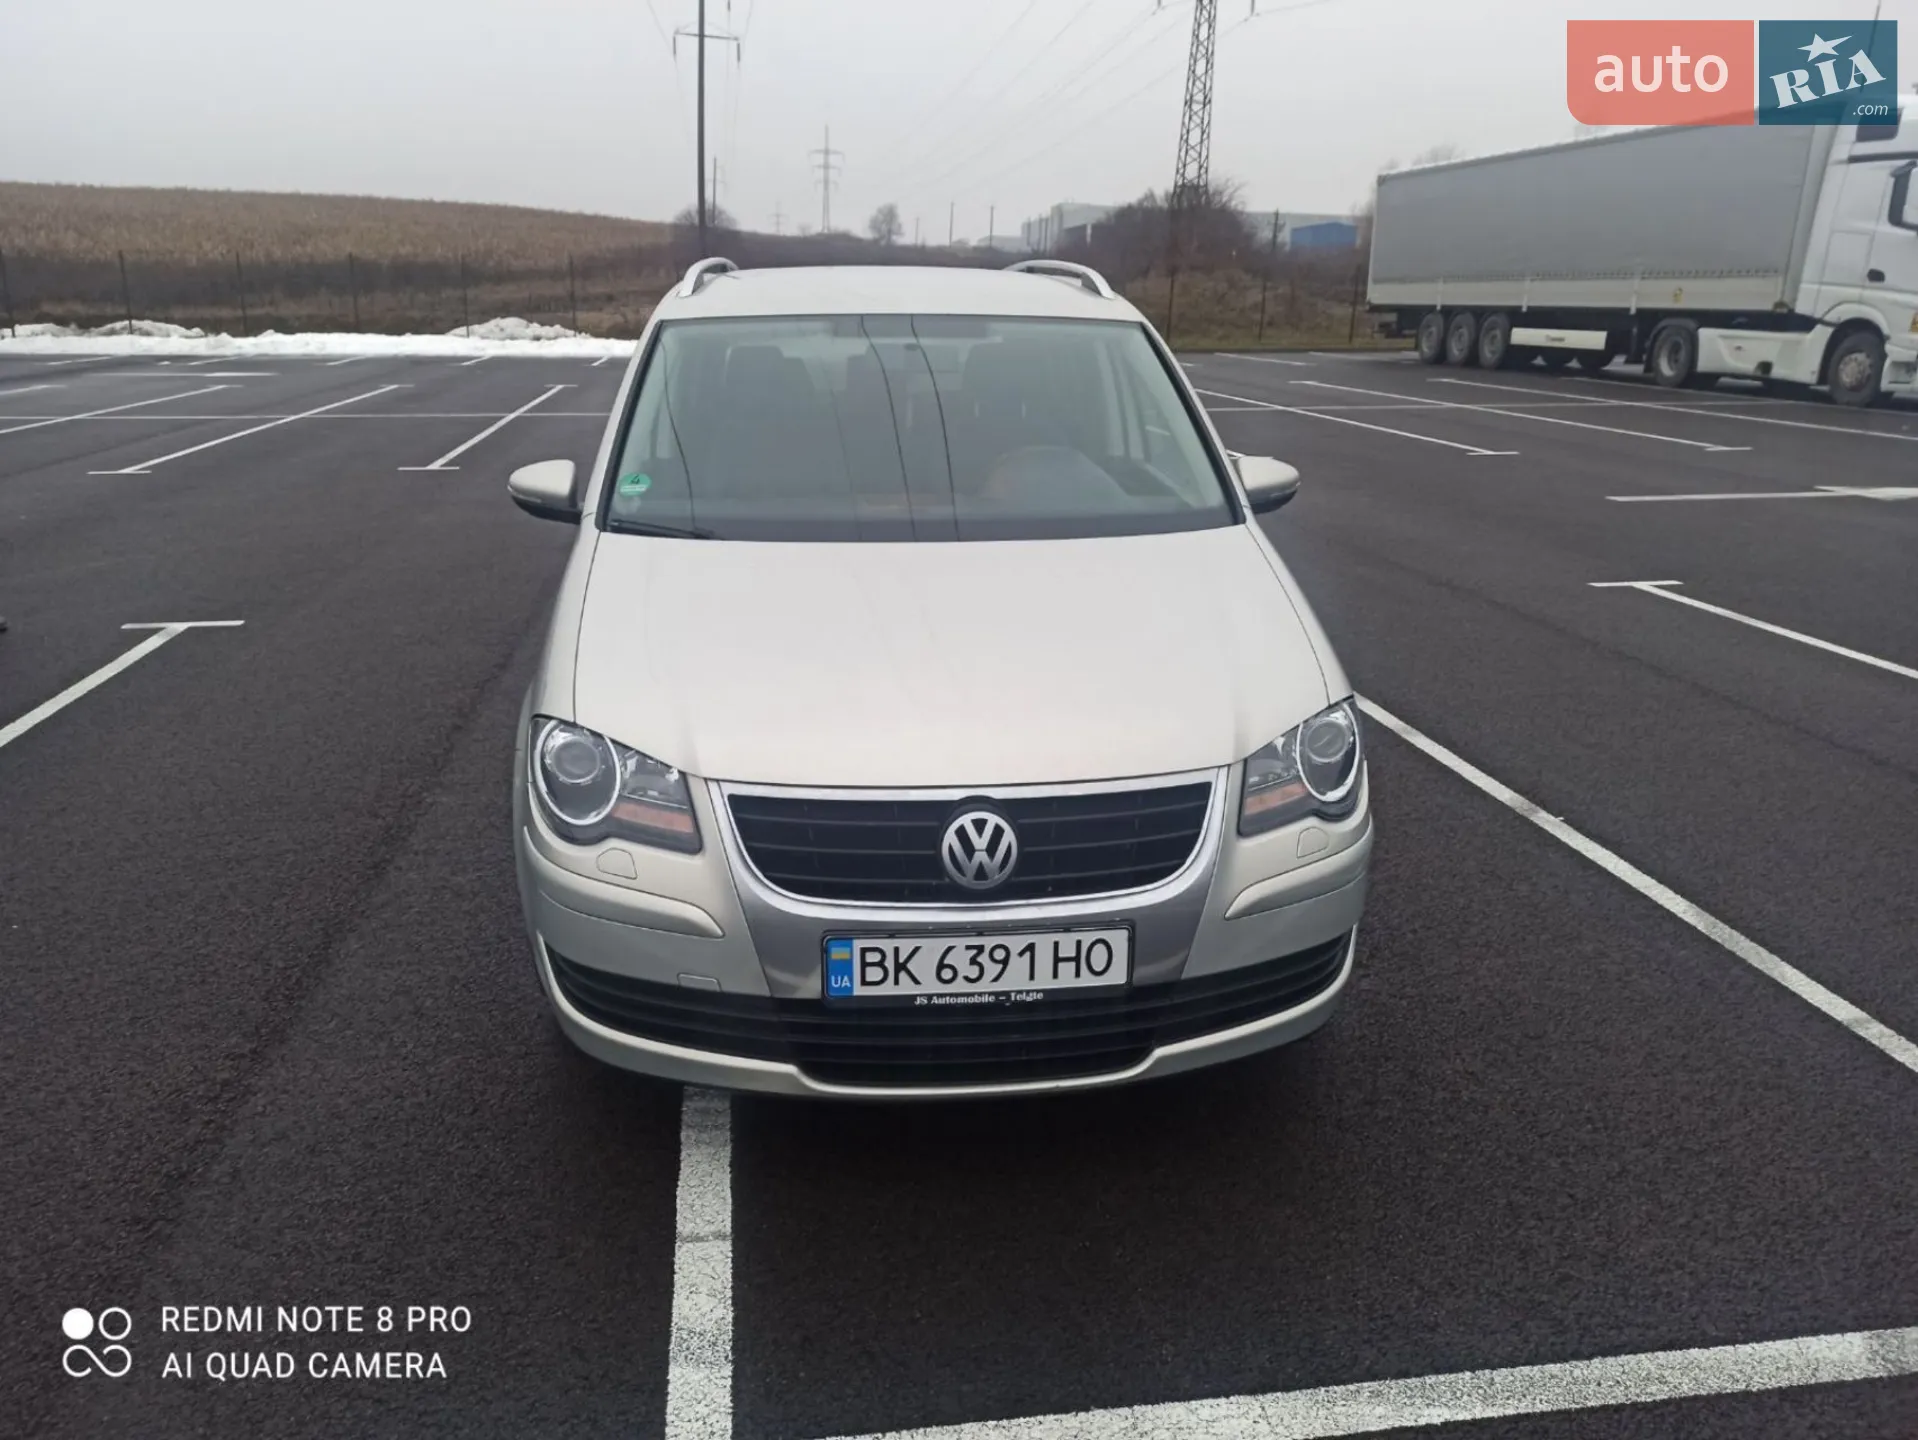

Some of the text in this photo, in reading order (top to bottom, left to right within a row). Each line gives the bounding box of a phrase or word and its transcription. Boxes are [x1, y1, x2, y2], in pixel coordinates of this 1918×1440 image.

[859, 937, 1114, 987] BK 6391 HO
[831, 975, 852, 988] UA
[914, 996, 928, 1006] JS
[931, 994, 996, 1005] Automobile
